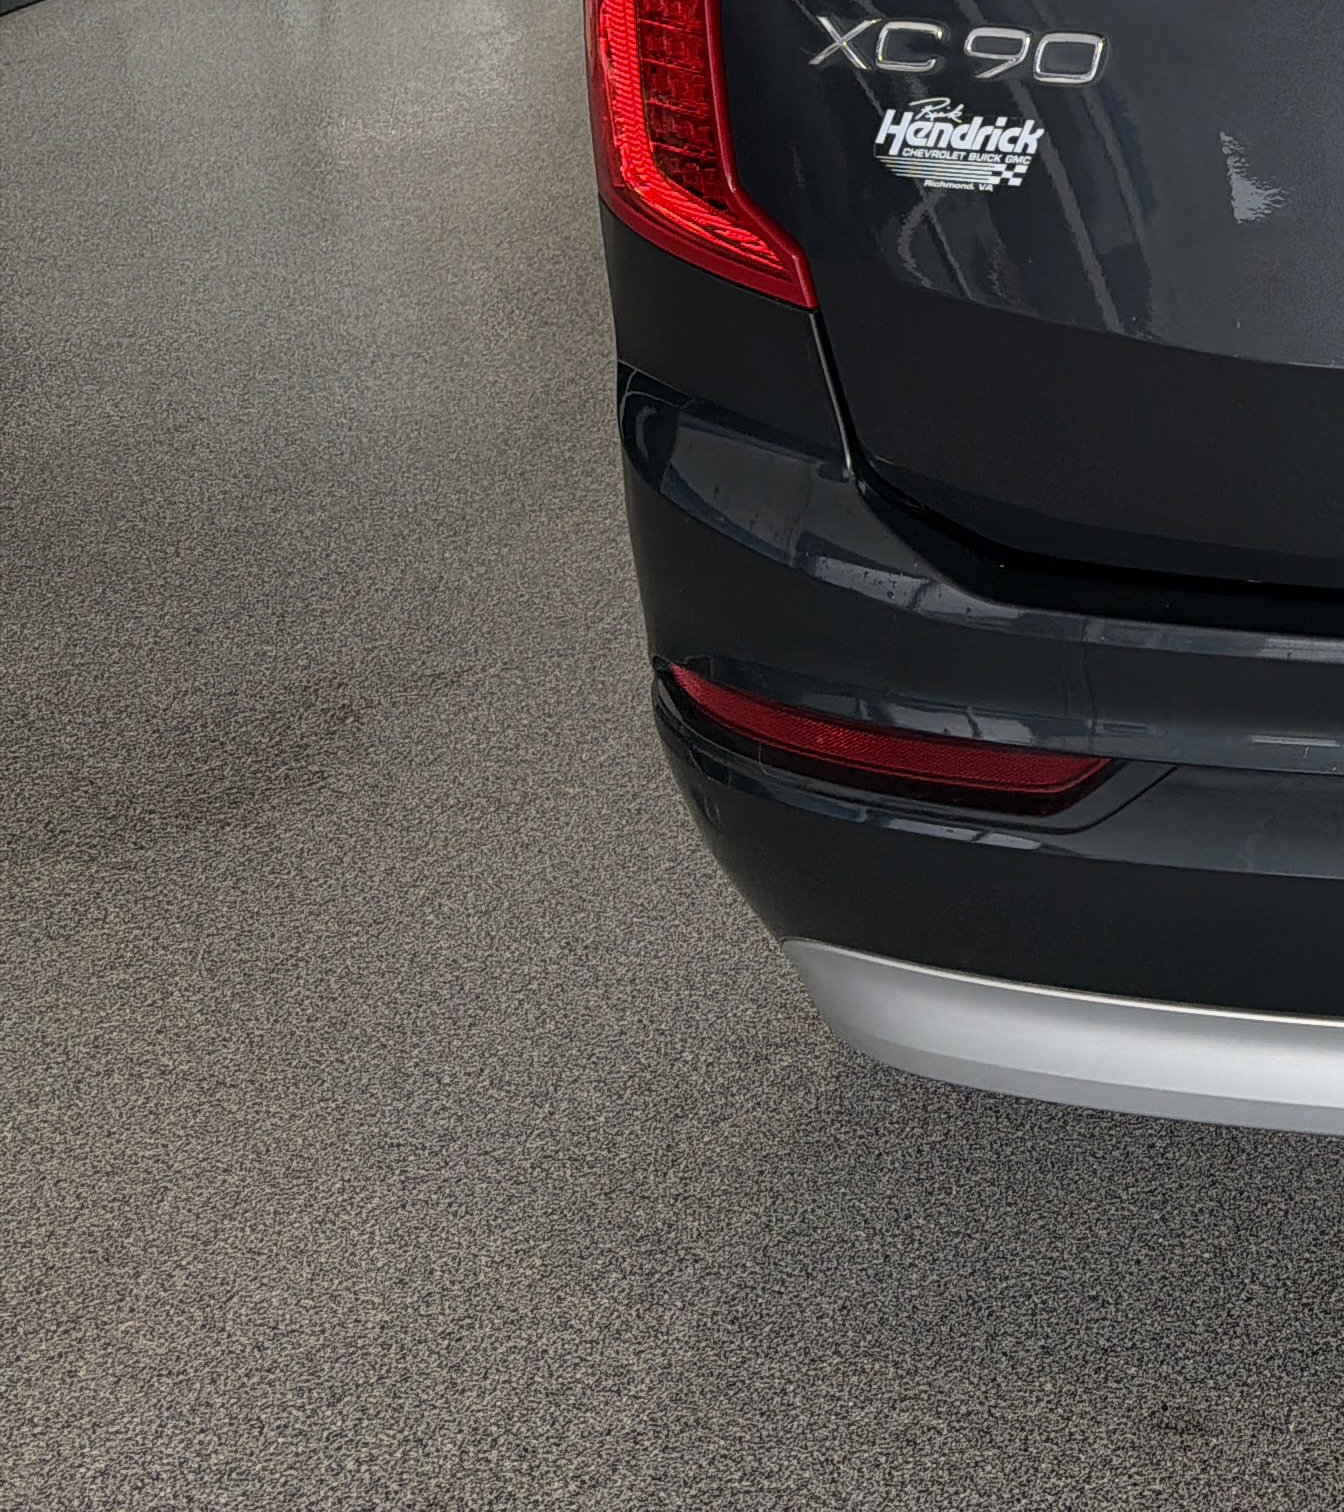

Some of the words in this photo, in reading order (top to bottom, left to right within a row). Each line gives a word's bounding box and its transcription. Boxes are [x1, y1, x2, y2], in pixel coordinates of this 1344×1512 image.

[875, 109, 1045, 156] Hendrick
[902, 147, 966, 161] CHEVROLET
[968, 153, 1002, 163] BUICK
[1005, 154, 1032, 165] GMC
[978, 183, 994, 192] VA
